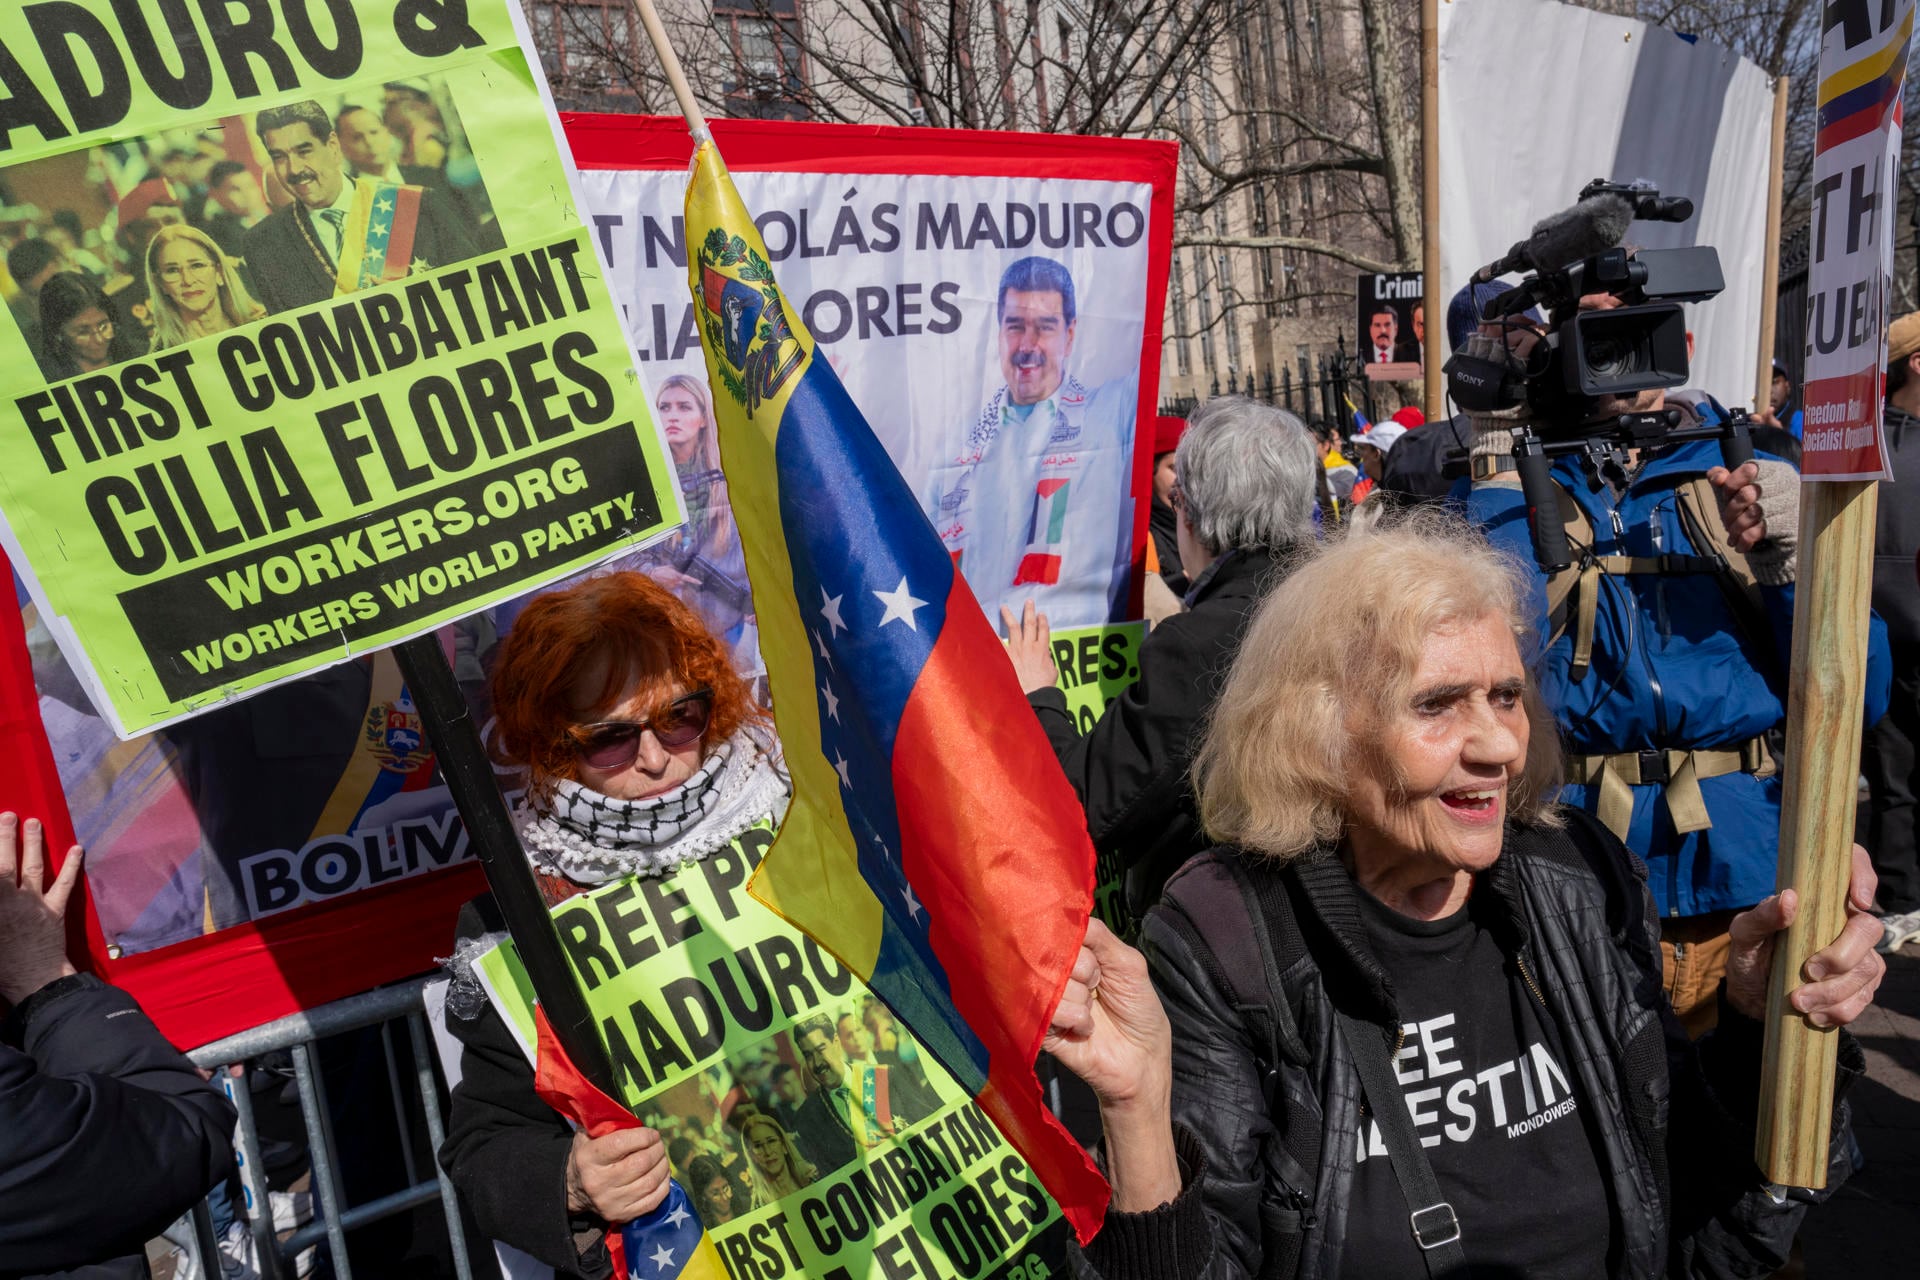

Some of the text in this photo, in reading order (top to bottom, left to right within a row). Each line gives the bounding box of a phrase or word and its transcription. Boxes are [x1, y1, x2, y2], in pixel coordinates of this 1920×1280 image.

[643, 186, 901, 268] NOLÁS
[916, 201, 1145, 250] MADURO
[15, 238, 593, 474] FIRST COMBATANT
[1456, 371, 1485, 386] SONY
[84, 331, 616, 576] CILIA FLORES
[1803, 427, 1844, 452] Socialist
[1804, 401, 1846, 425] Freedom
[206, 457, 588, 611] WORKERS.ORG
[181, 491, 635, 675] WORKERS WORLD PARTY
[1050, 633, 1138, 690] RES.
[250, 805, 478, 913] BOLIV
